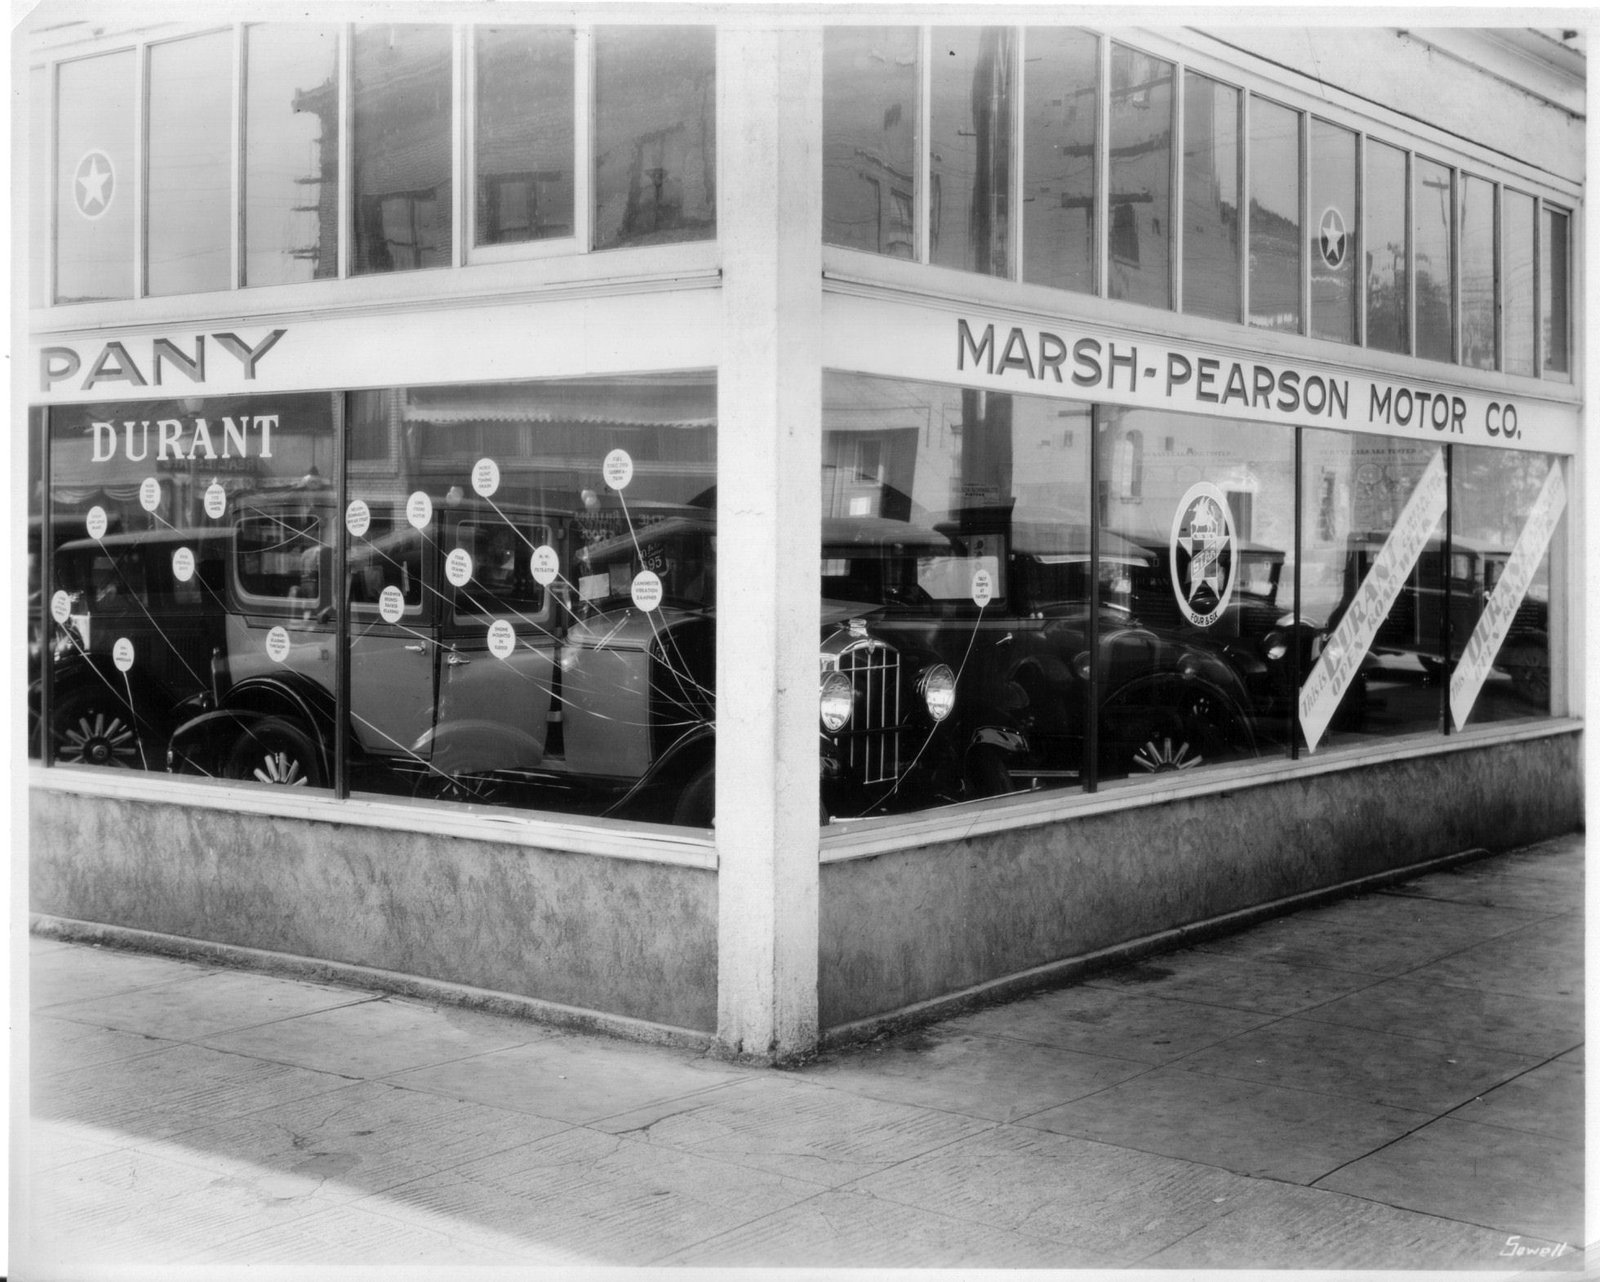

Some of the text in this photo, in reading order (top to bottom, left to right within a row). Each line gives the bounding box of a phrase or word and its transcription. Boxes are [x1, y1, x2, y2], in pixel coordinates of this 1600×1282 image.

[40, 329, 288, 392] PANY
[957, 318, 1521, 440] MARSH-PEARSON MOTOR CO.
[91, 414, 279, 462] DURANT
[1192, 550, 1216, 575] STAR
[1190, 612, 1204, 626] FOUR
[1209, 611, 1218, 624] SIX
